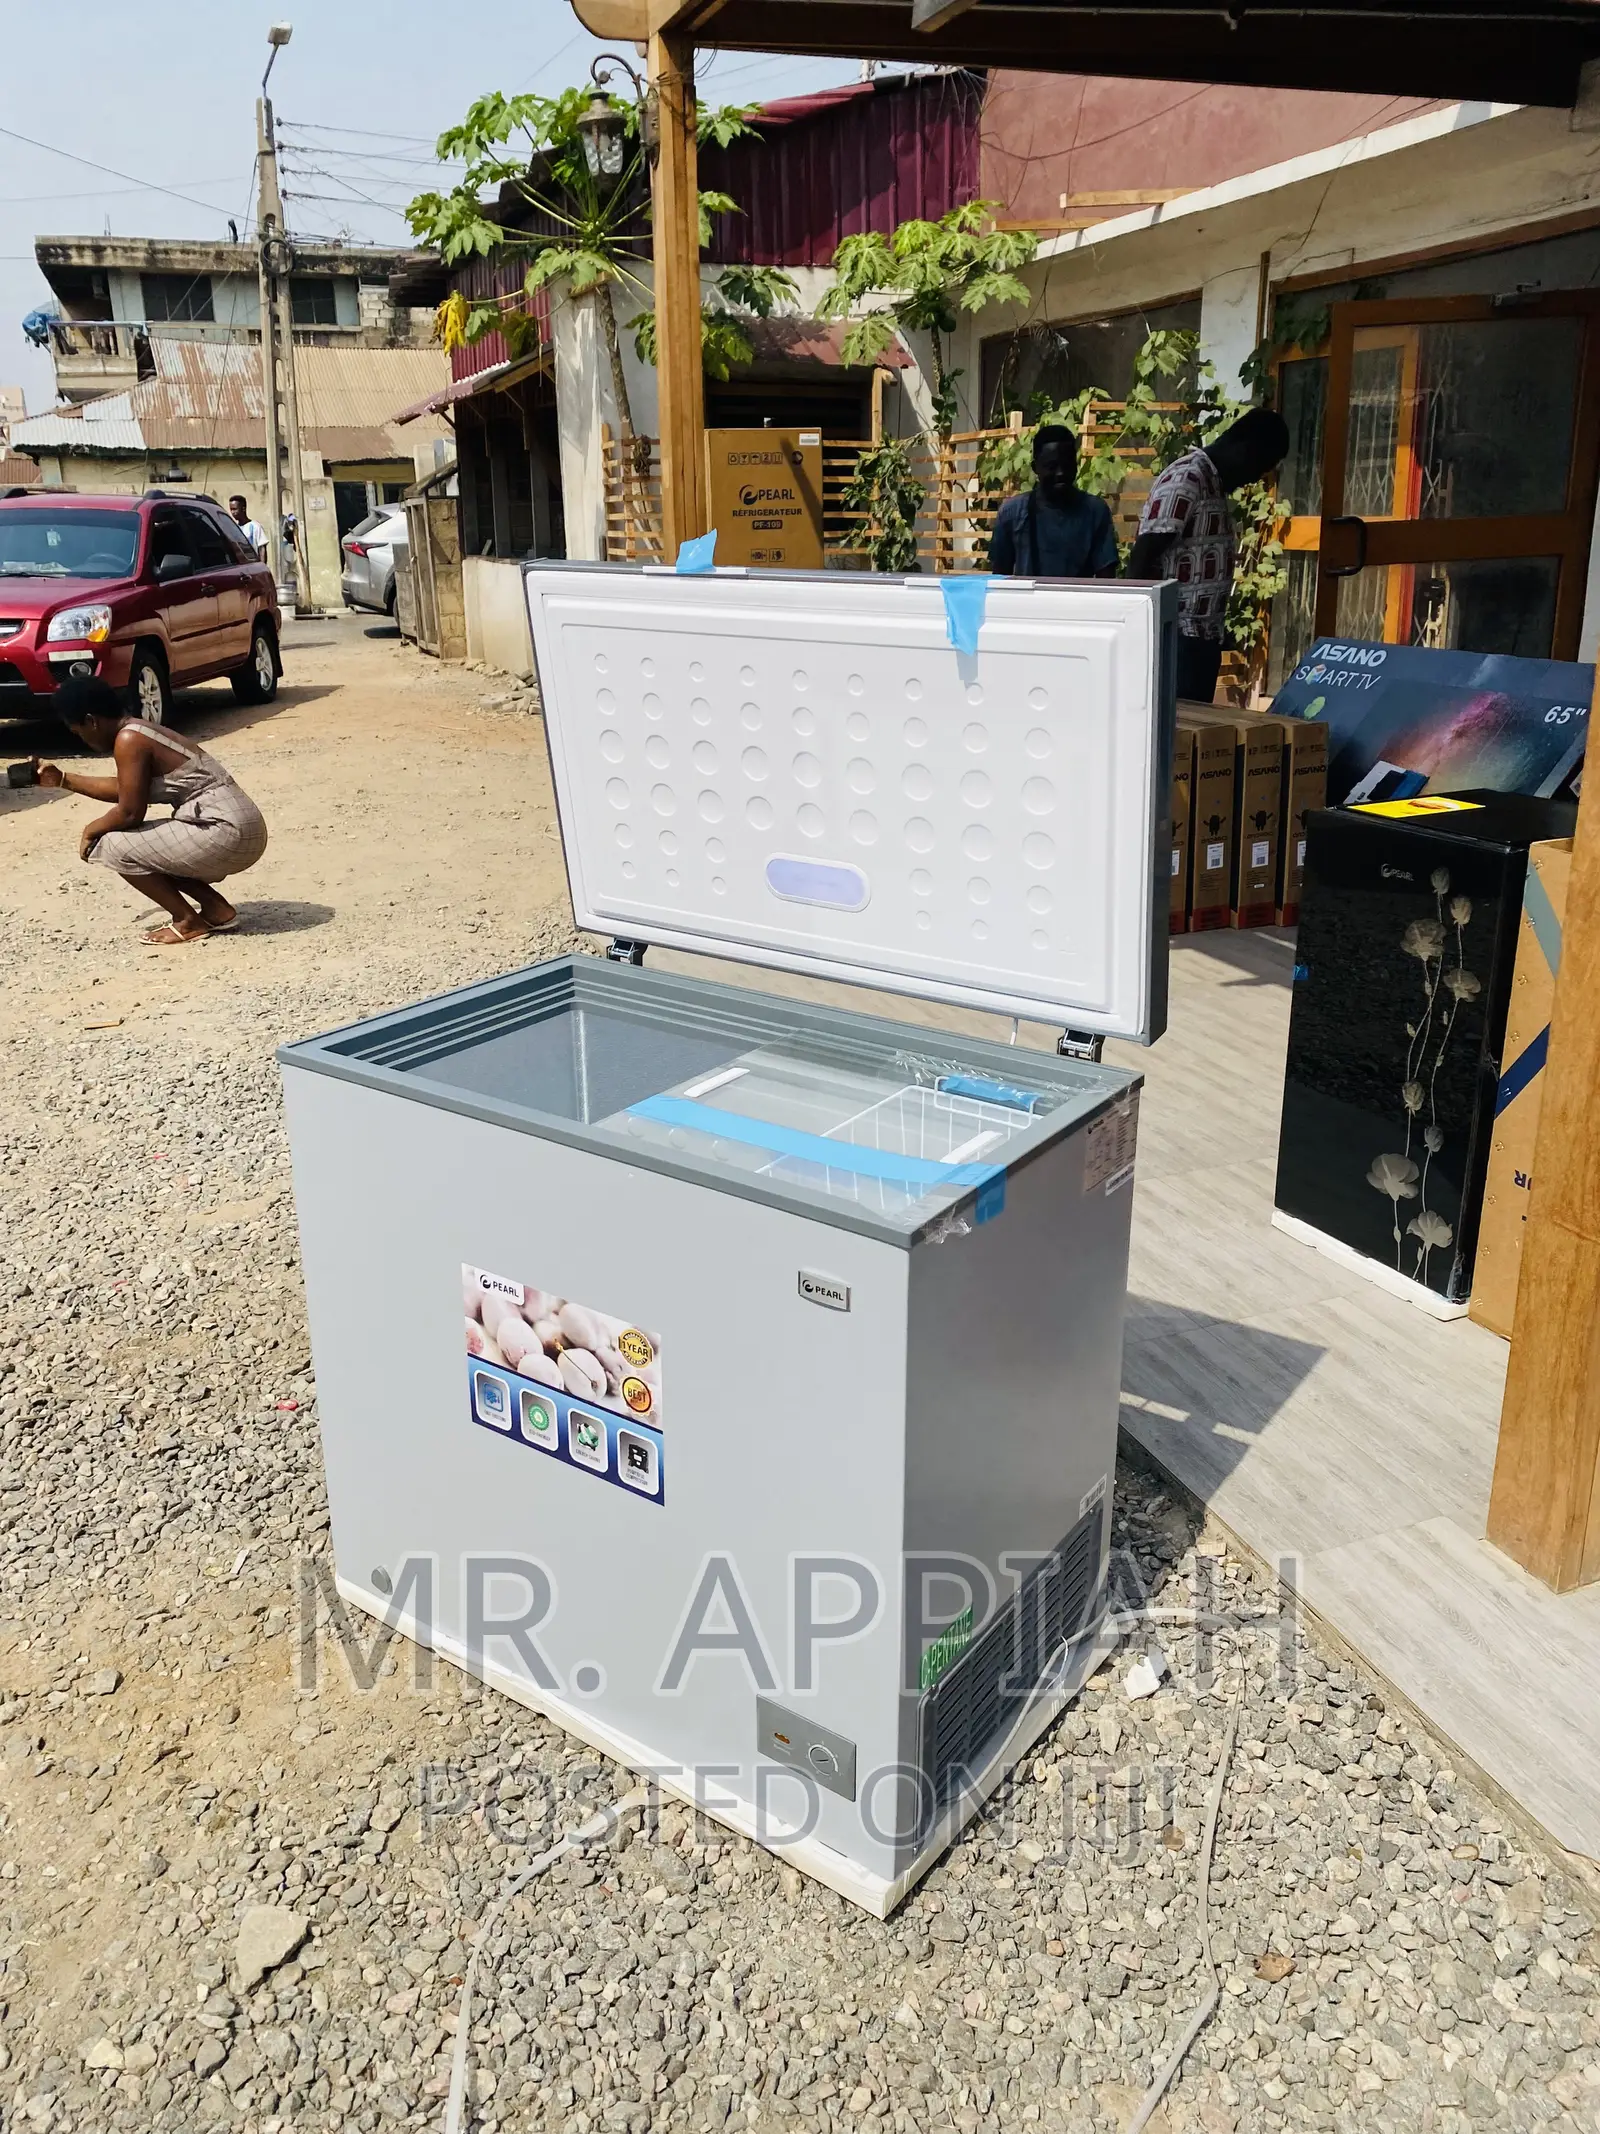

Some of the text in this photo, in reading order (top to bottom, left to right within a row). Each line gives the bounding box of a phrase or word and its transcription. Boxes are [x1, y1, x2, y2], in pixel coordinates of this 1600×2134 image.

[758, 488, 795, 501] PEARL
[1311, 643, 1387, 667] ASANO
[1296, 664, 1381, 690] SMART TV
[1544, 705, 1587, 725] 65"
[1200, 767, 1232, 780] ASANO
[1248, 764, 1280, 777] ASANO
[1293, 764, 1327, 776] ASANO
[1391, 868, 1414, 881] PEARL
[492, 1280, 519, 1298] PEARL
[815, 1285, 844, 1301] PEARL
[627, 1341, 649, 1358] YEAR
[627, 1387, 646, 1403] BEST
[921, 1607, 971, 1689] C-PENTANE
